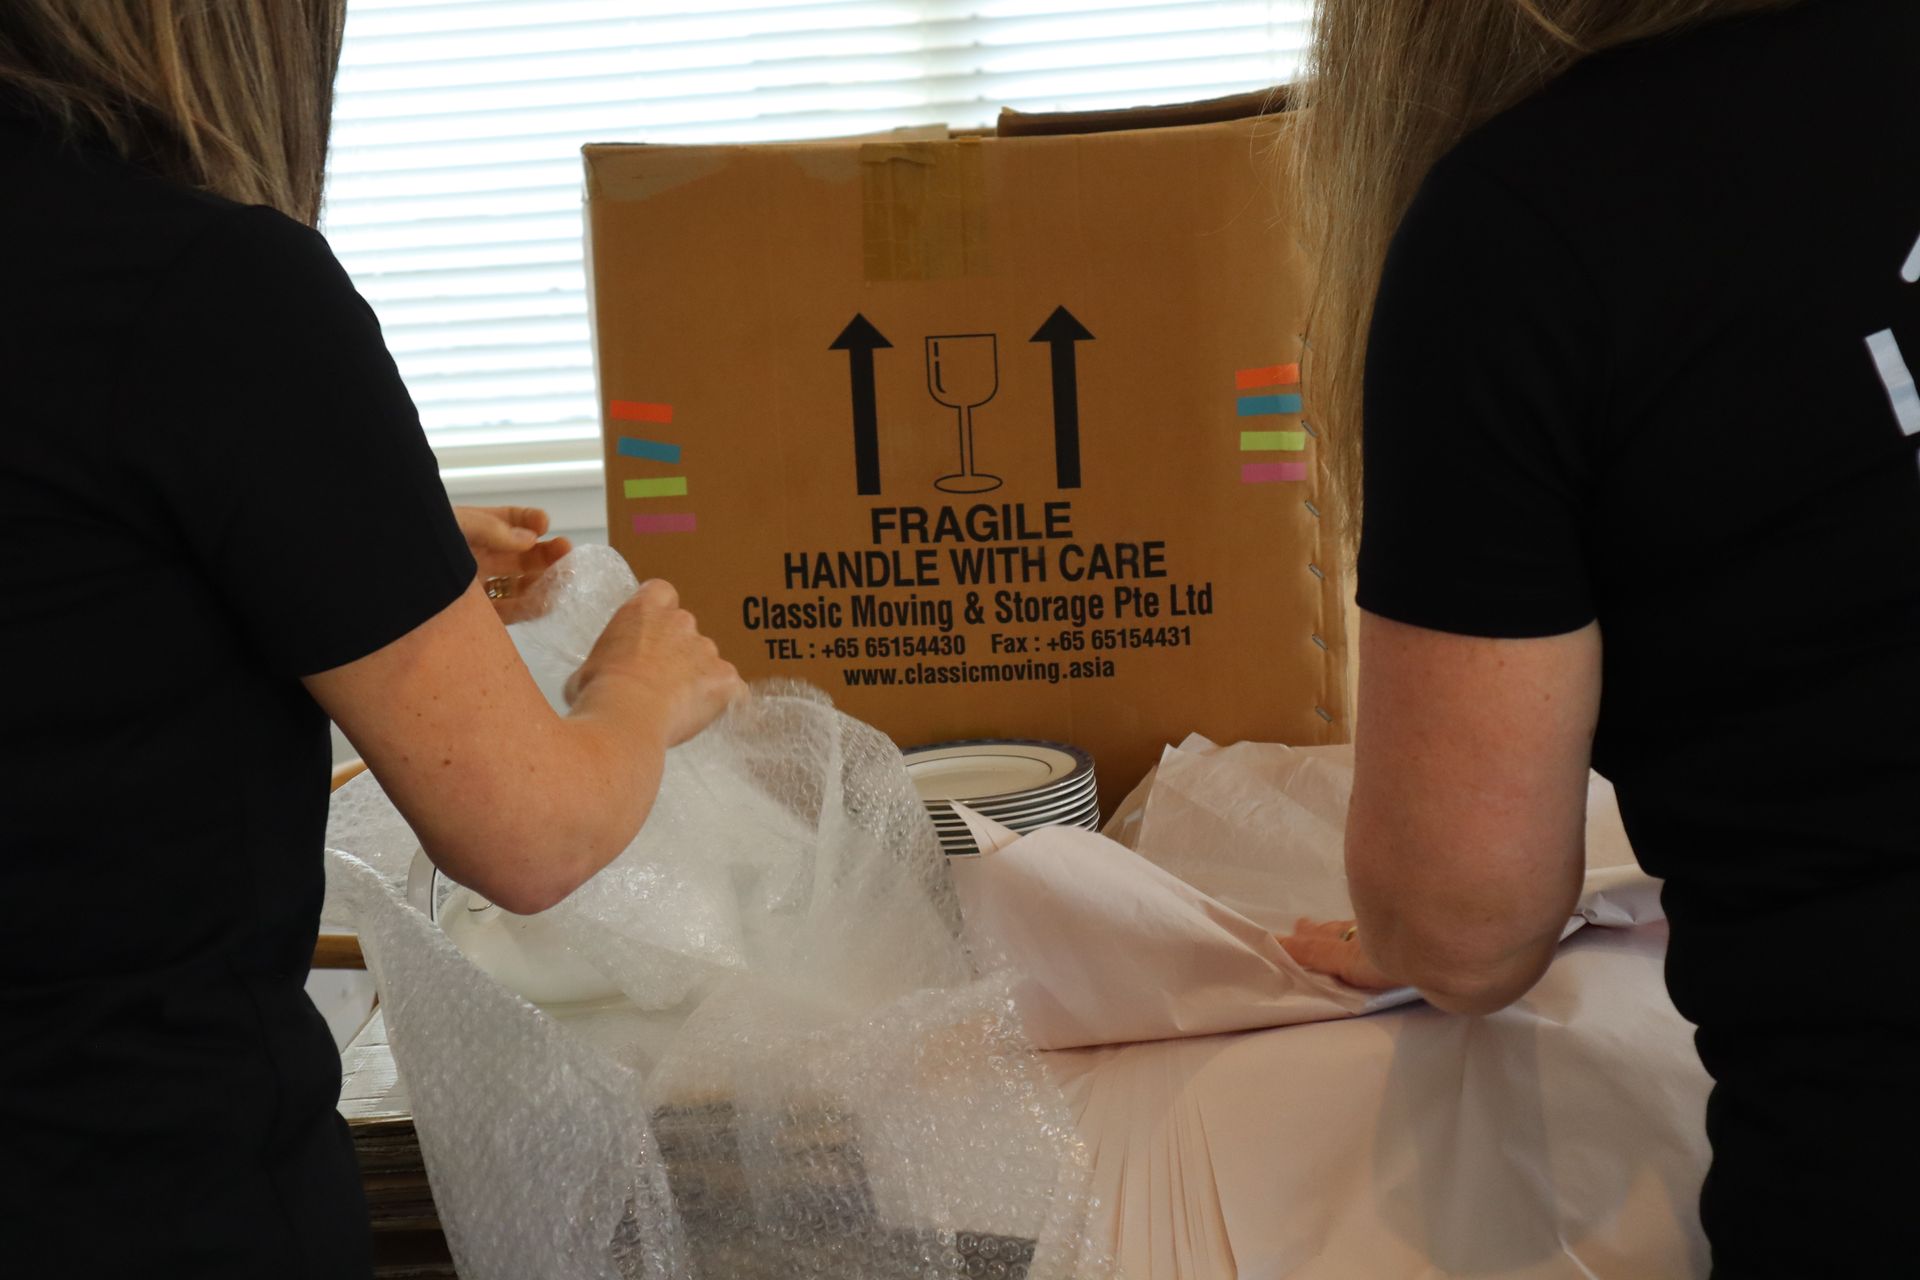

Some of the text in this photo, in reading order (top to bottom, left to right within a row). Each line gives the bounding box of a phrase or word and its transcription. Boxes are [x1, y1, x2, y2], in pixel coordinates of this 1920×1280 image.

[870, 501, 1074, 545] FRAGILE
[783, 540, 1168, 590] HANDLE WITH CARE
[742, 582, 1214, 633] Classic Moving & Storage Pte Ltd
[820, 637, 860, 659] +65
[864, 634, 967, 659] 65154430
[1046, 630, 1086, 653] +65
[1090, 625, 1192, 651] 65154431
[842, 655, 1116, 687] www.classicmoving.asia
